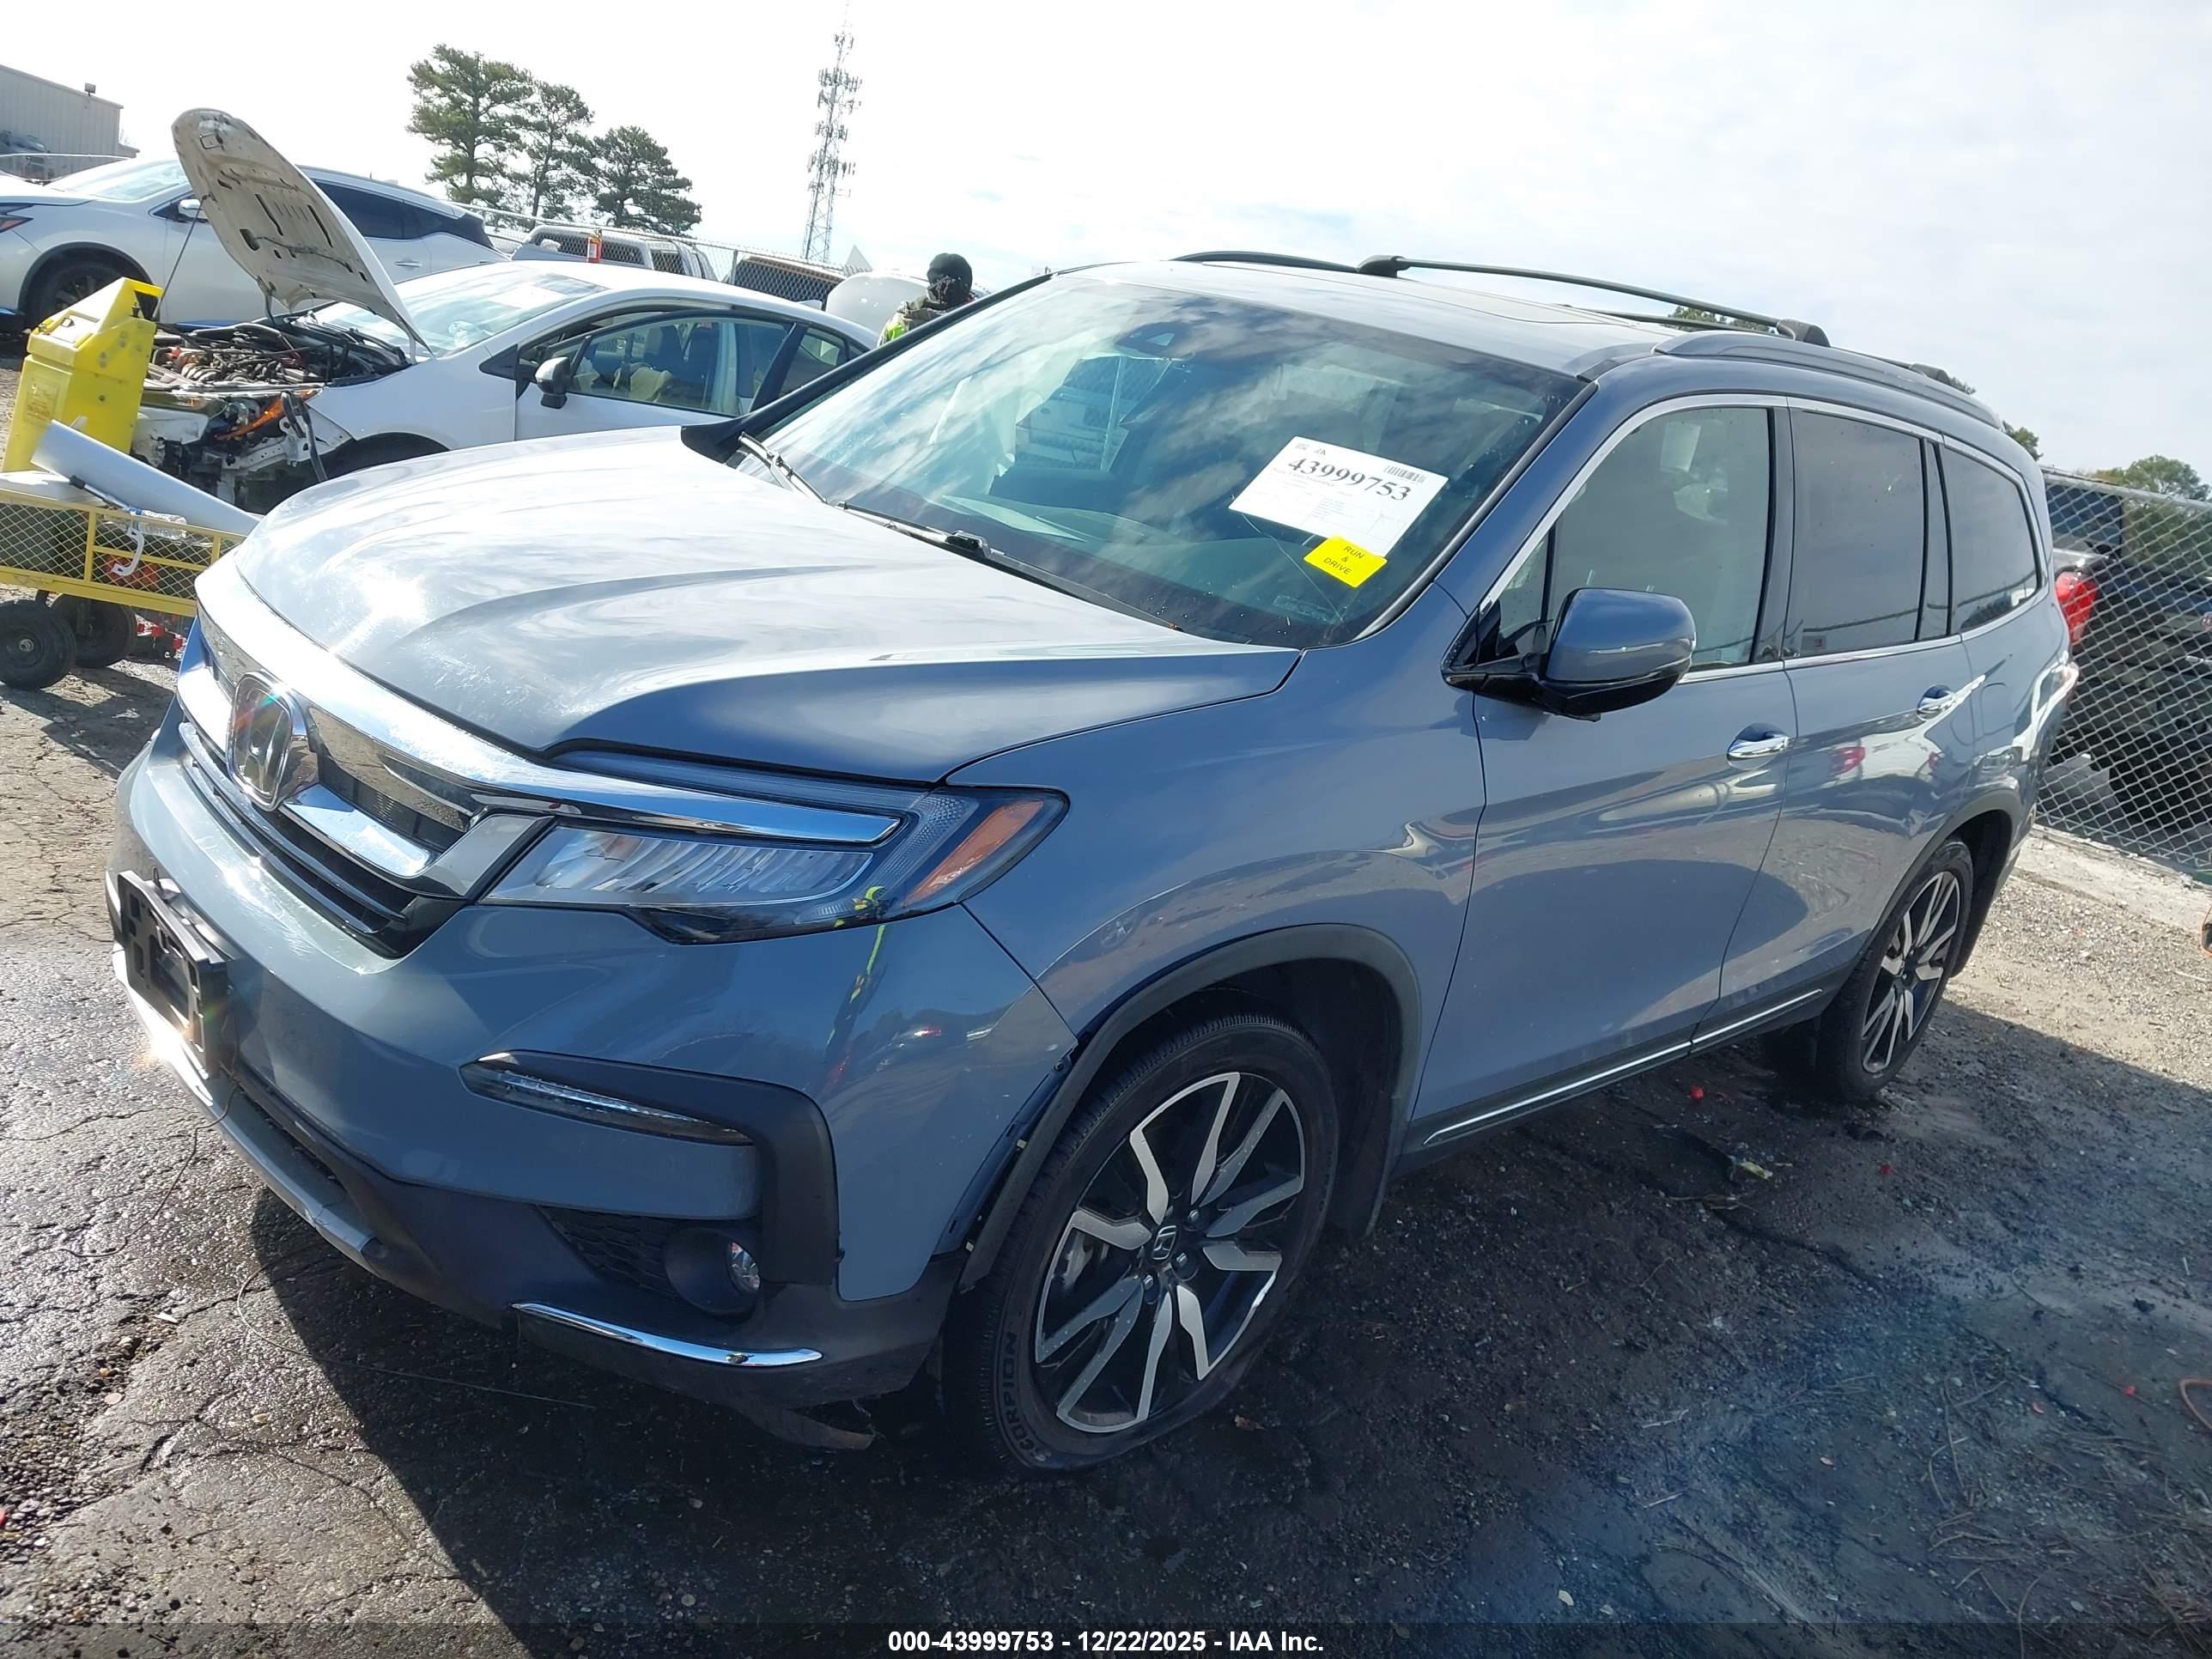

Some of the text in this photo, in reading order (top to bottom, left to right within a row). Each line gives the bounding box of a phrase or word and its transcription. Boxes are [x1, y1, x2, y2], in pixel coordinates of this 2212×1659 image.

[1287, 458, 1413, 501] 43999753
[1343, 545, 1365, 559] RUN
[1323, 556, 1352, 575] DRIVE
